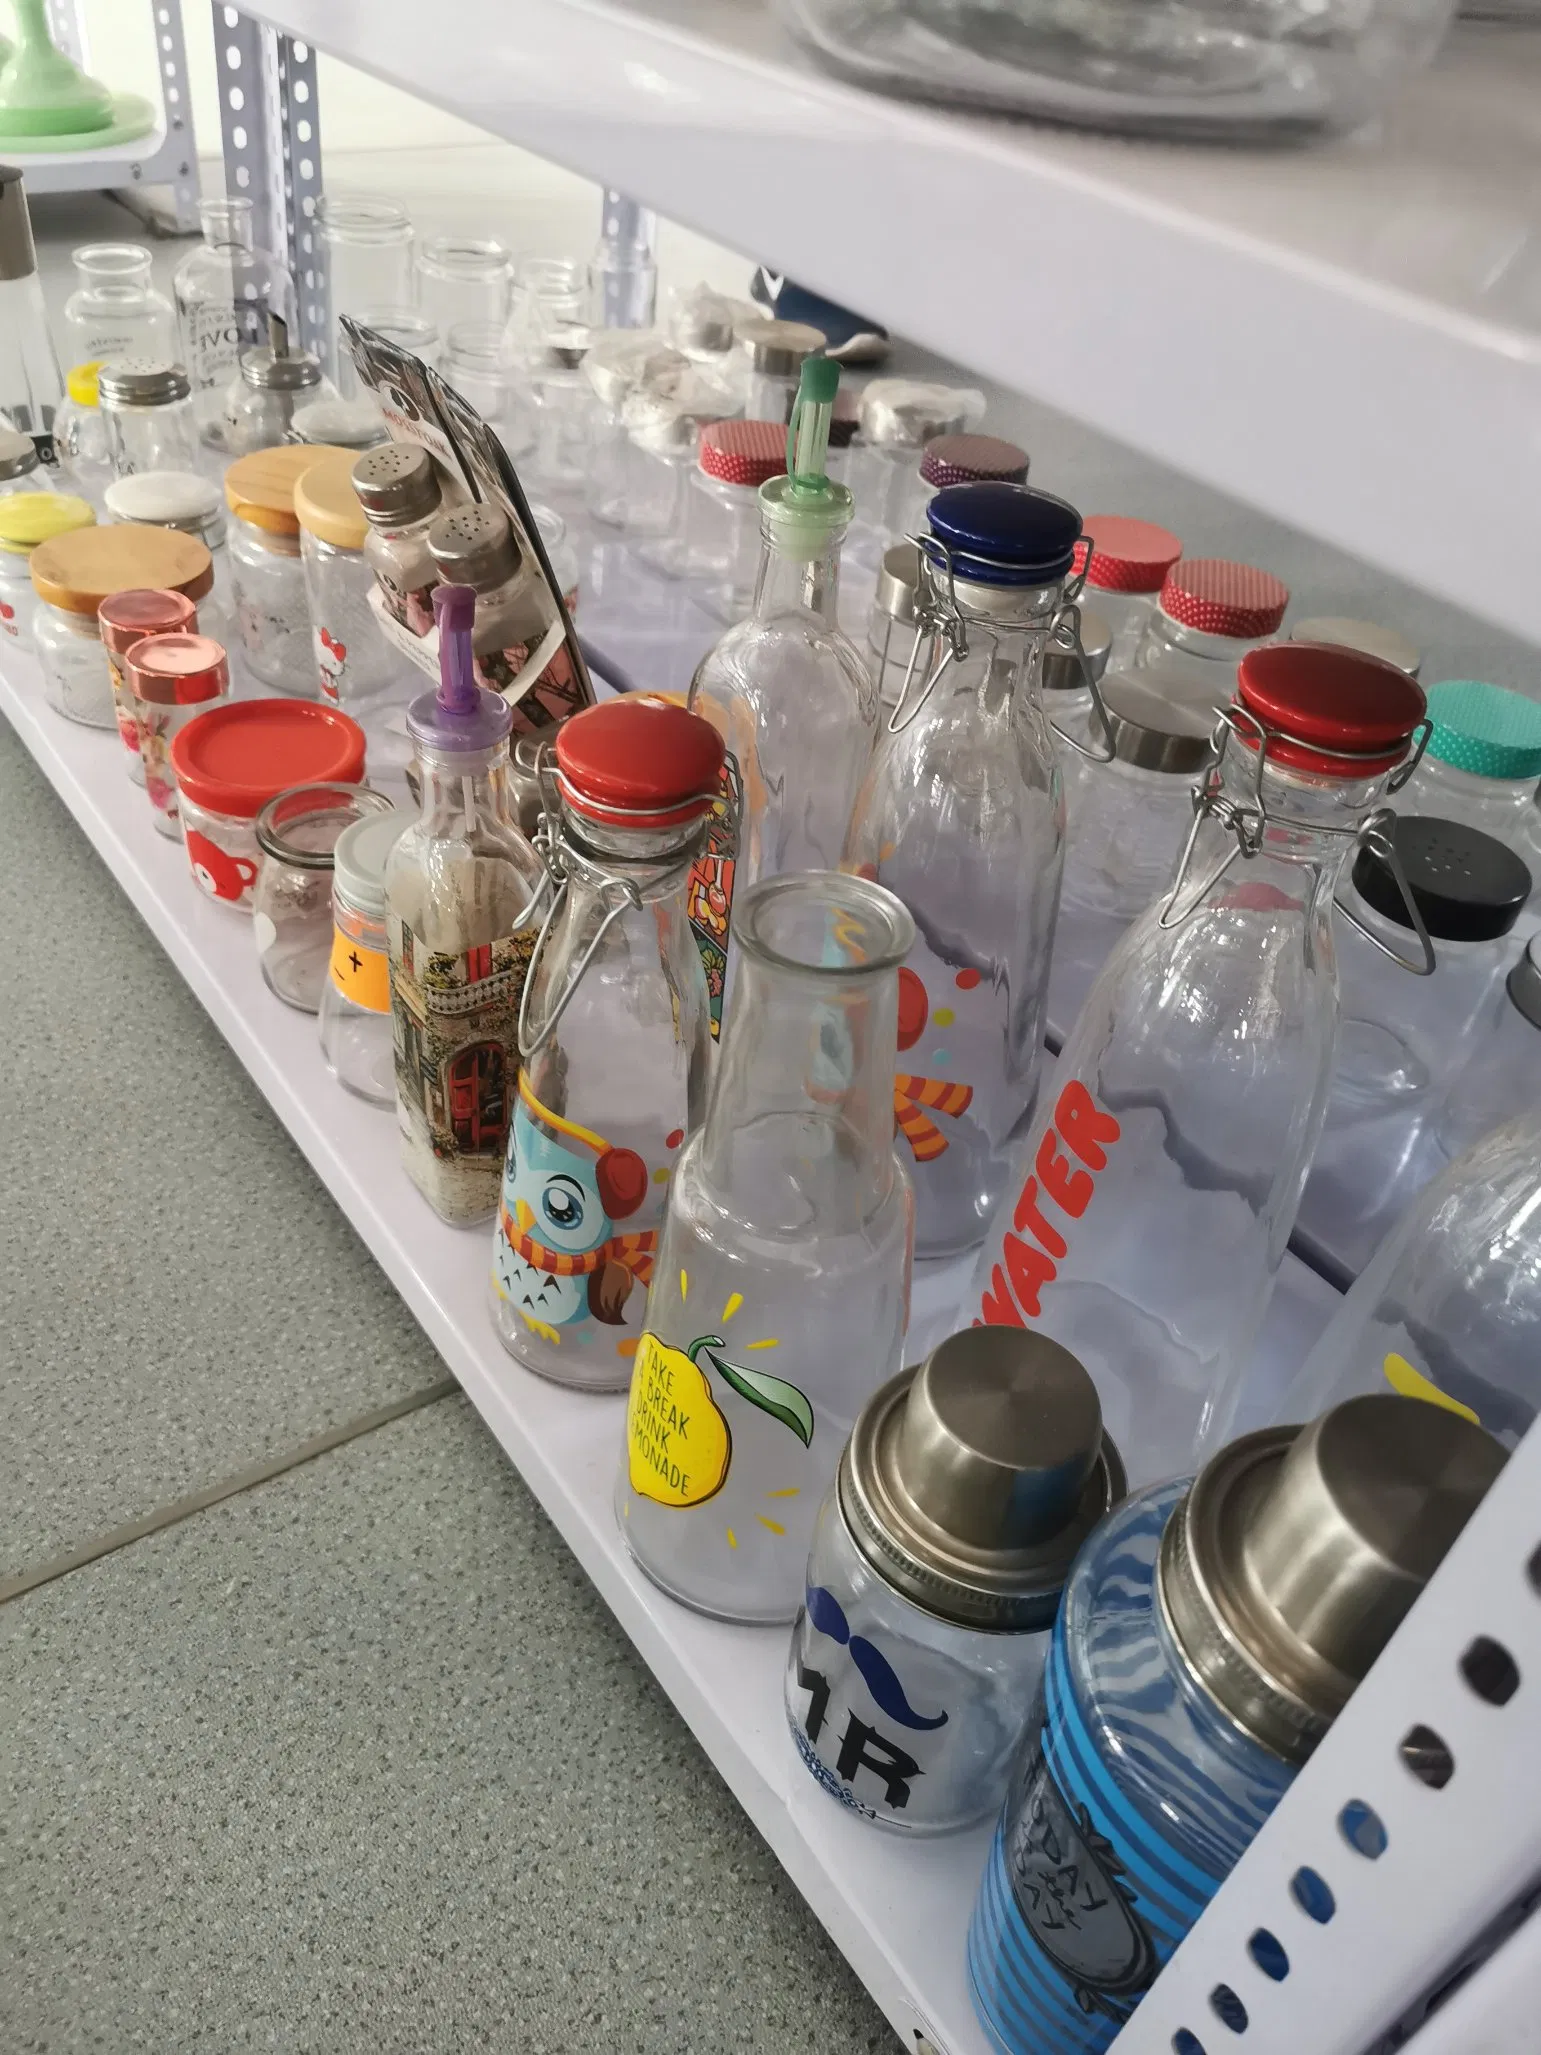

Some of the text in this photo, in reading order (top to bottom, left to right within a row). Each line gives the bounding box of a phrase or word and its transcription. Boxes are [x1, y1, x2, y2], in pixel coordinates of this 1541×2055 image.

[648, 1341, 676, 1397] TAKE
[636, 1389, 671, 1454] DRINK
[646, 1376, 691, 1441] BREAK
[630, 1410, 691, 1498] EMONADE
